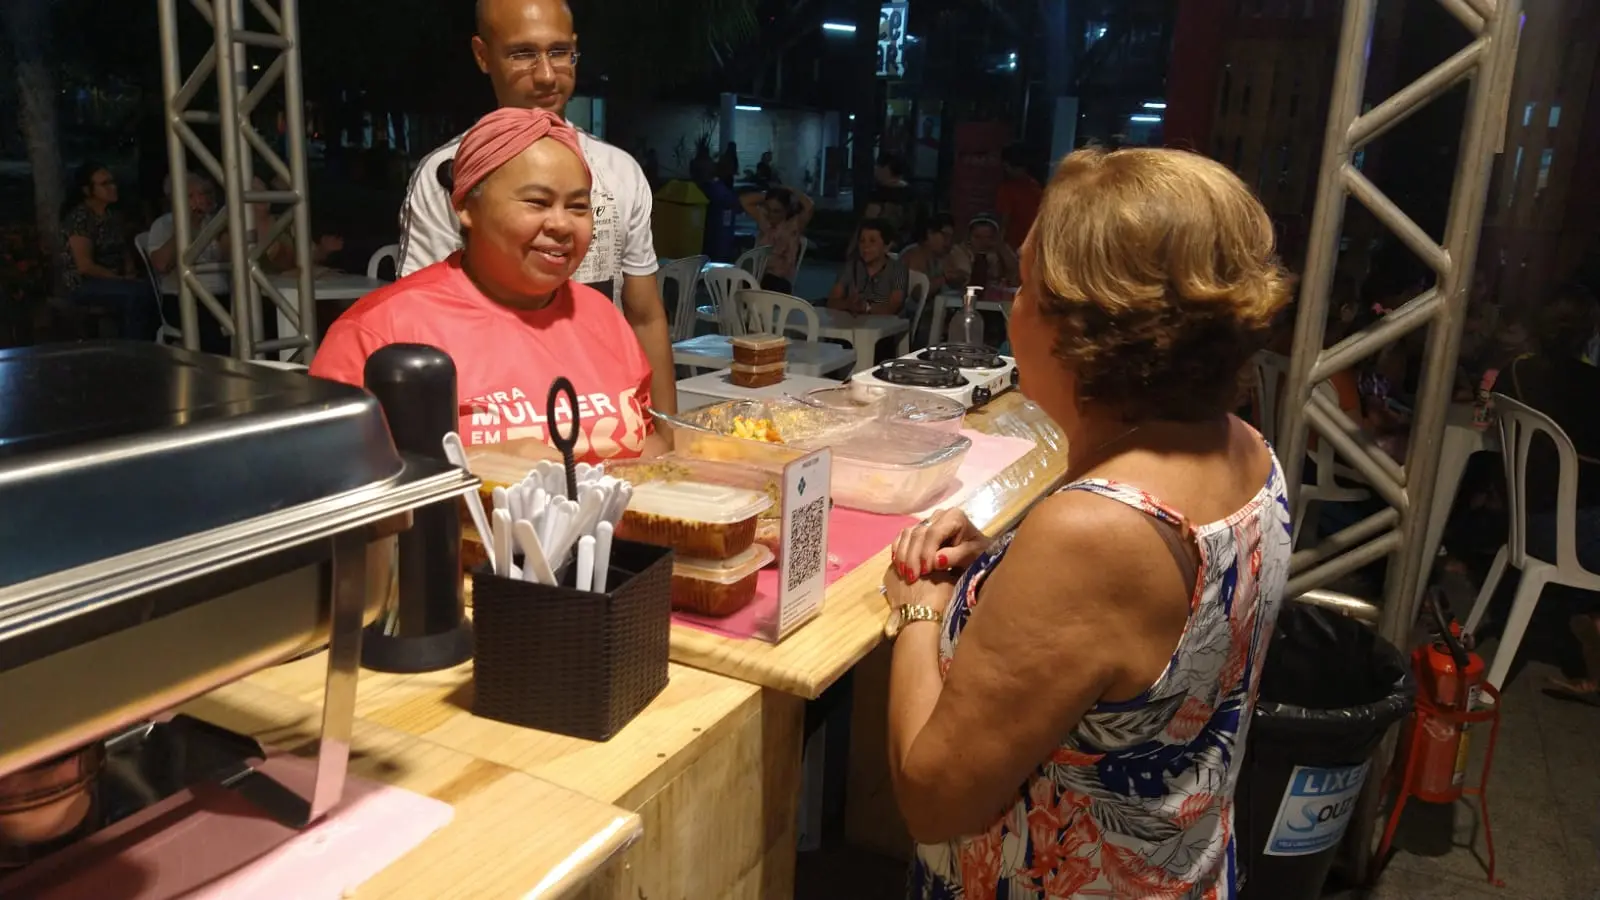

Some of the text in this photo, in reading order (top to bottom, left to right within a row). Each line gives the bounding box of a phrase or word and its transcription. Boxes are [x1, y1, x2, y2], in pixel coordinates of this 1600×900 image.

[464, 386, 526, 404] EIRA
[471, 393, 617, 426] MULHER
[471, 430, 501, 445] EM
